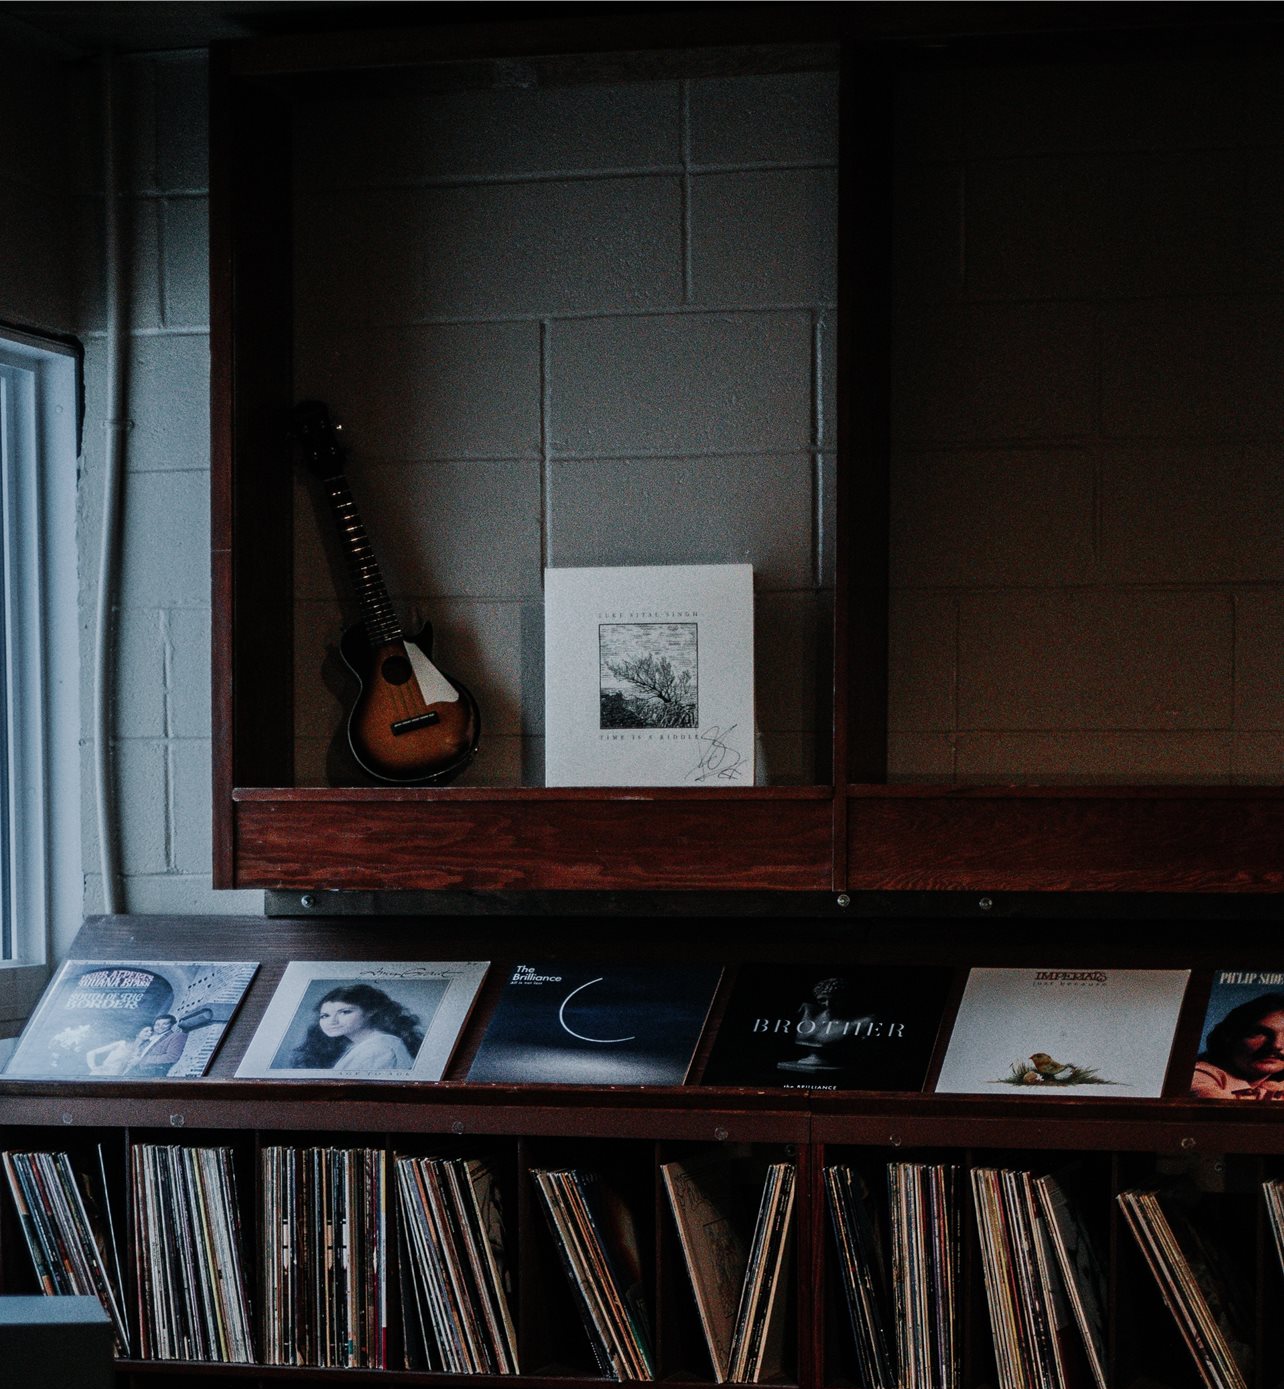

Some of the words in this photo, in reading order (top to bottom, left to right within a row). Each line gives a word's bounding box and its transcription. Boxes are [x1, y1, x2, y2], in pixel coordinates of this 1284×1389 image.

[516, 964, 536, 974] The
[511, 973, 563, 983] Brilliance
[1034, 972, 1107, 983] IMPERIALS
[752, 1018, 905, 1038] BROTHER
